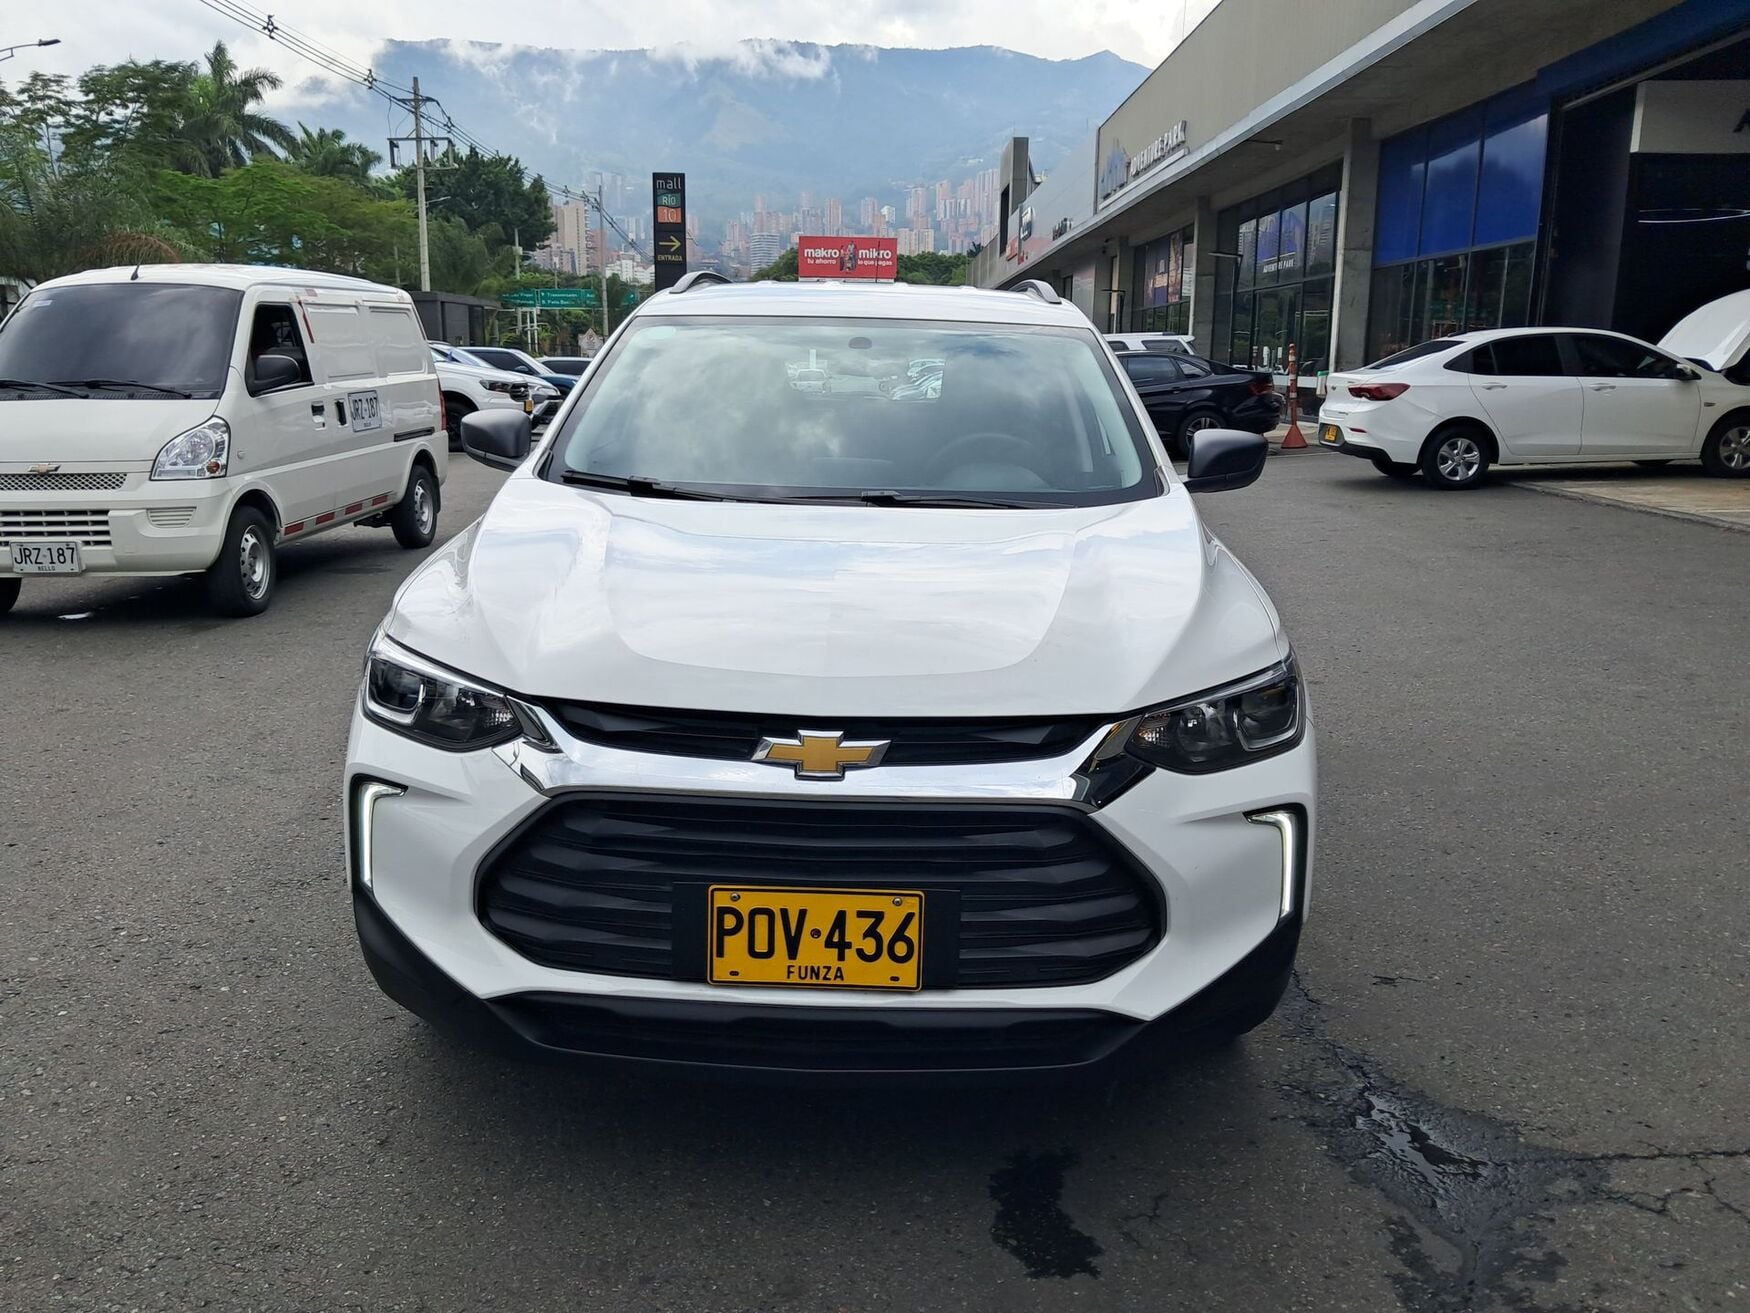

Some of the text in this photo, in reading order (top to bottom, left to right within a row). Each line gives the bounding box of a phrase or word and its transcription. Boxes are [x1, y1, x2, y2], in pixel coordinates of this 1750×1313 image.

[656, 177, 681, 190] mall
[664, 209, 677, 223] 10
[804, 248, 892, 258] makro mikro
[786, 965, 844, 982] FUNZA
